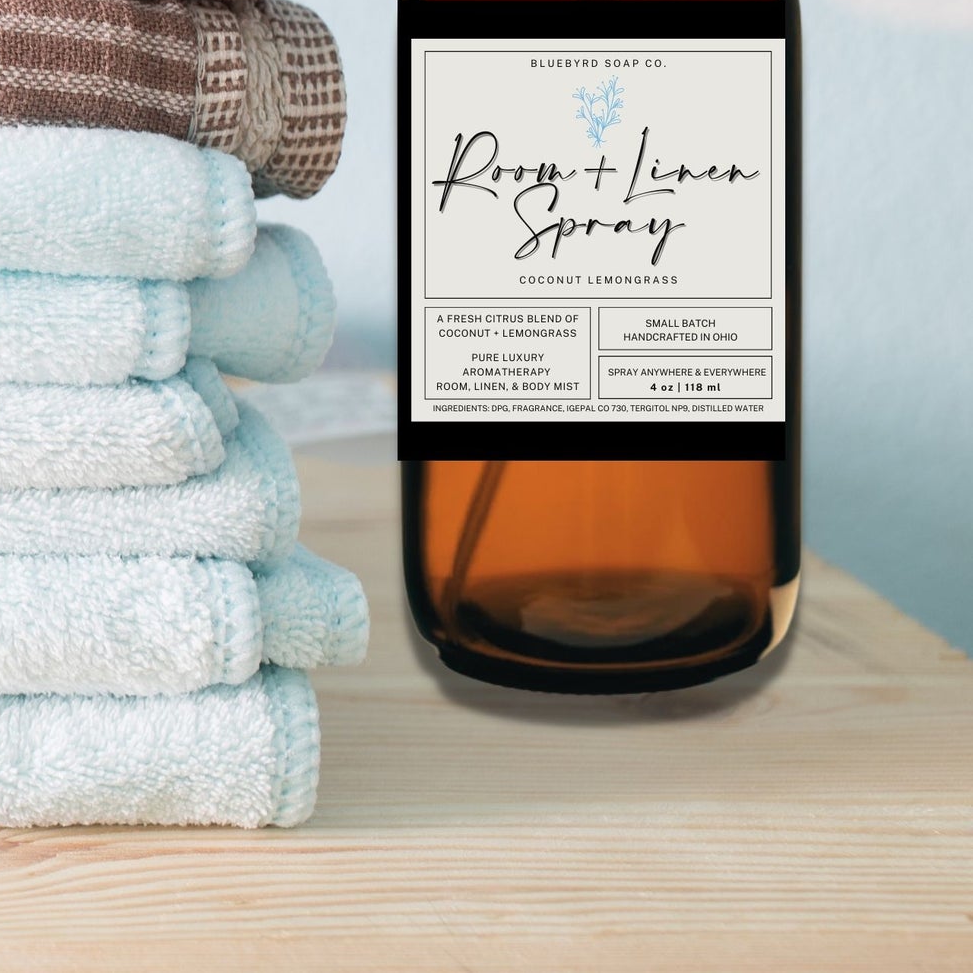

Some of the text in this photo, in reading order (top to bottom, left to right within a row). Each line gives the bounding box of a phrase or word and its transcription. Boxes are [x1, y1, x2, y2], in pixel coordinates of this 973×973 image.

[530, 58, 667, 68] BLUEBYRD SOAP CO.
[432, 131, 576, 213] Room
[623, 127, 760, 204] Linen
[513, 182, 686, 266] Spray
[519, 275, 678, 285] COCONUT LEMONGRASS
[436, 314, 579, 324] A FRESH CITRUS BLEND OF
[645, 318, 716, 328] SMALL BATCH
[438, 328, 491, 338] COCONUT
[502, 328, 577, 338] LEMONGRASS
[623, 332, 738, 342] HANDCRAFTED IN OHIO
[471, 352, 545, 363] PURE LUXURY
[462, 367, 551, 377] AROMATHERAPY
[607, 367, 767, 377] SPRAY ANYWHERE & EVERYWHERE
[436, 381, 580, 392] ROOM, LINEN, & BODY MIST
[649, 382, 658, 392] 4
[660, 384, 674, 392] oz
[684, 382, 703, 392] 118
[706, 382, 721, 392] ml
[432, 404, 765, 413] INGREDIENTS: DPG, FRAGRANCE, IGEPAL CO 730, TERGITOL NP9, DISTILLED WATER
